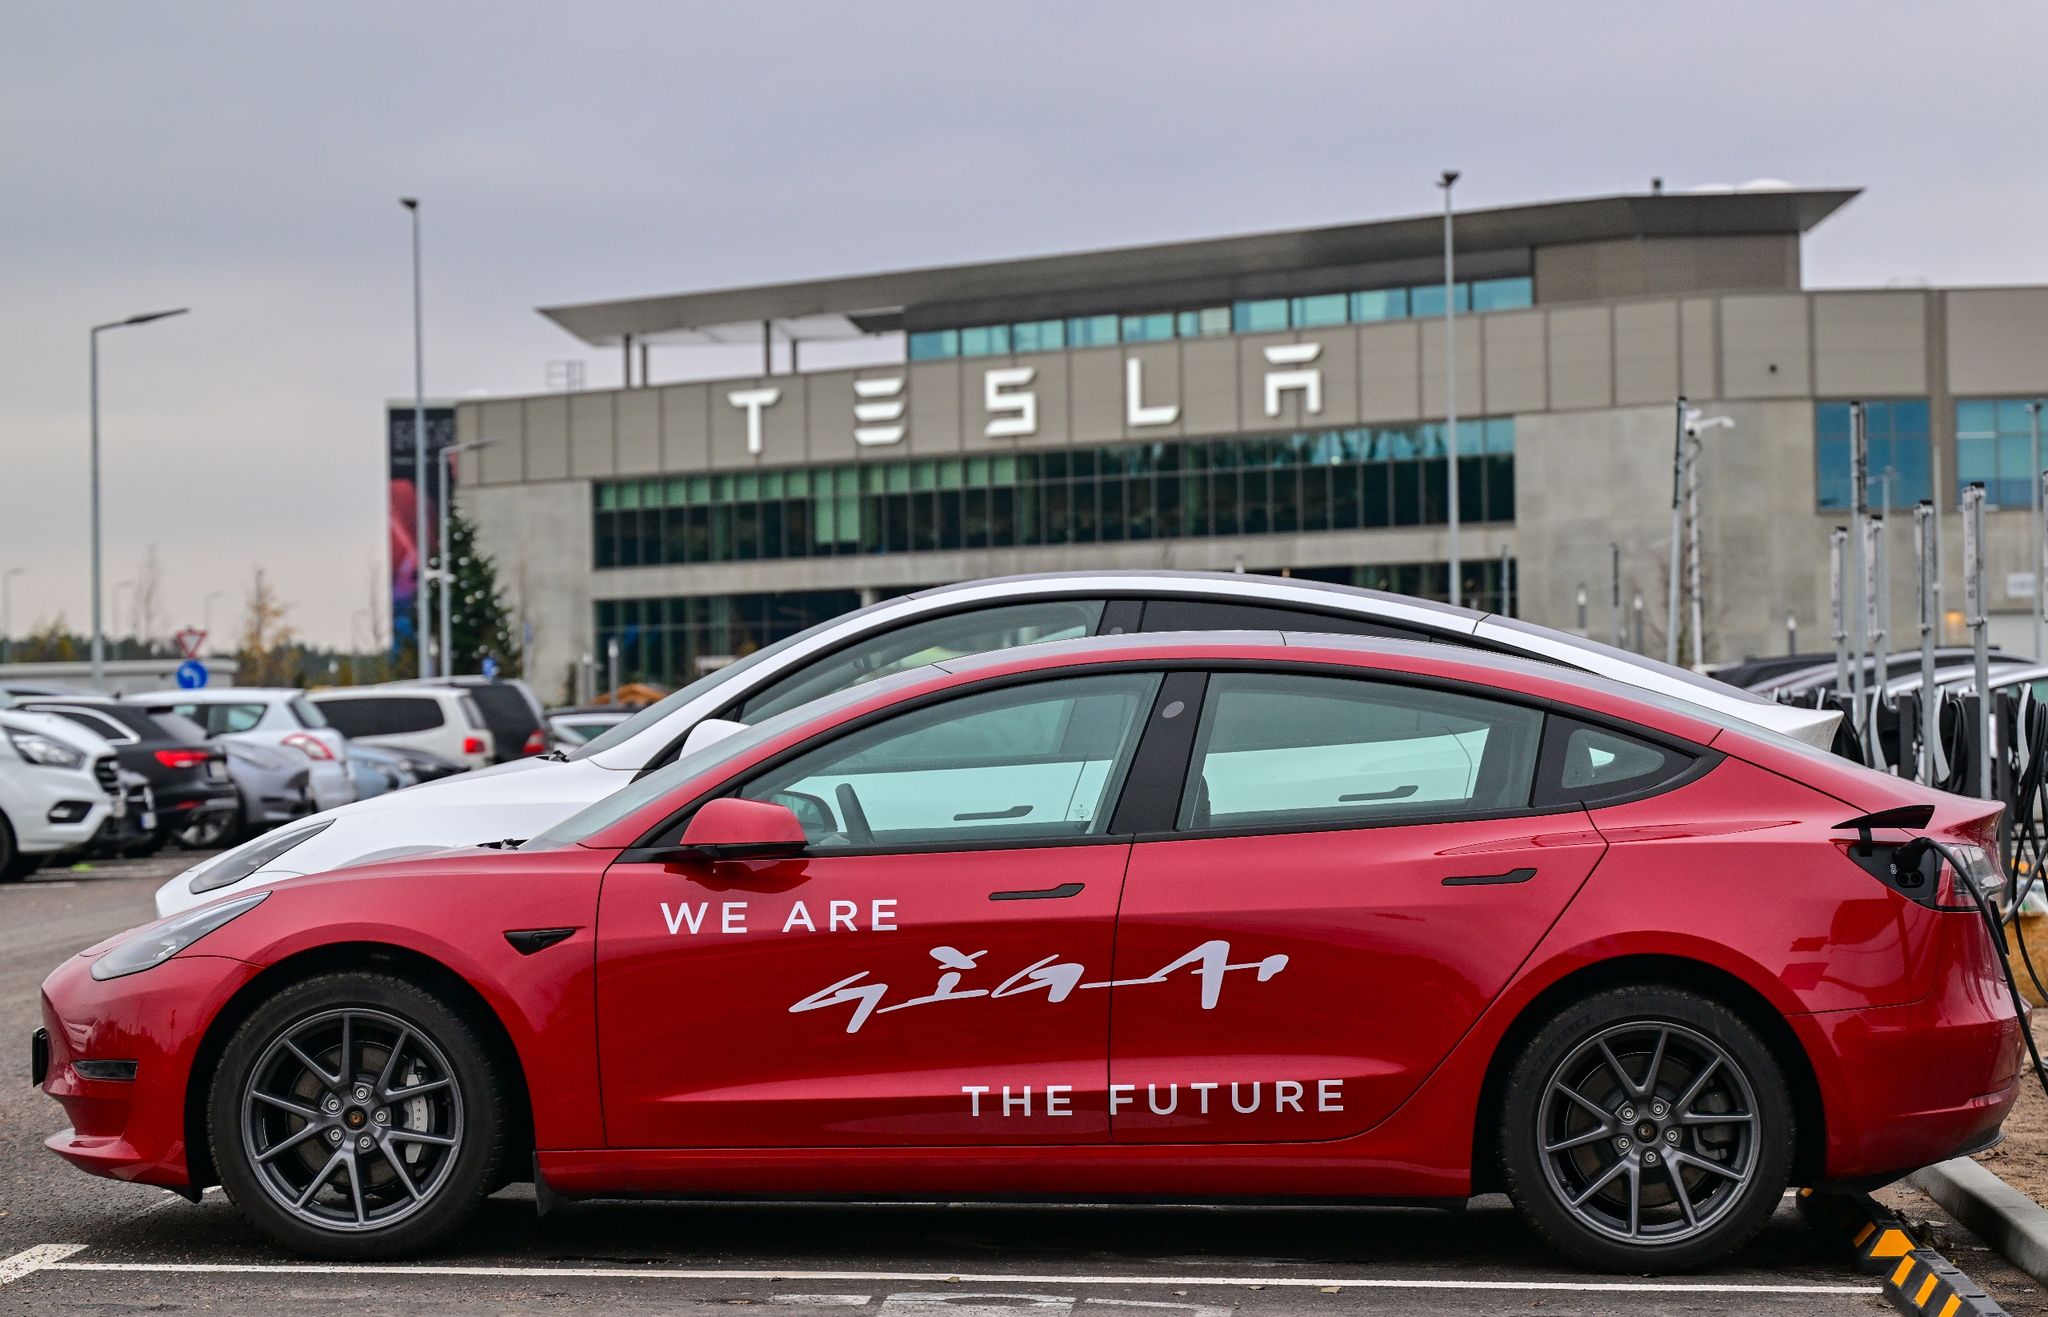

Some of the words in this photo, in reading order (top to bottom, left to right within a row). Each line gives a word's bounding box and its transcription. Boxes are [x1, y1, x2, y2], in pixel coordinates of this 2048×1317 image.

[728, 342, 1322, 454] TESLA
[660, 900, 748, 935] WE
[781, 898, 900, 934] ARE
[961, 1083, 1074, 1118] THE
[1108, 1078, 1346, 1116] FUTURE
